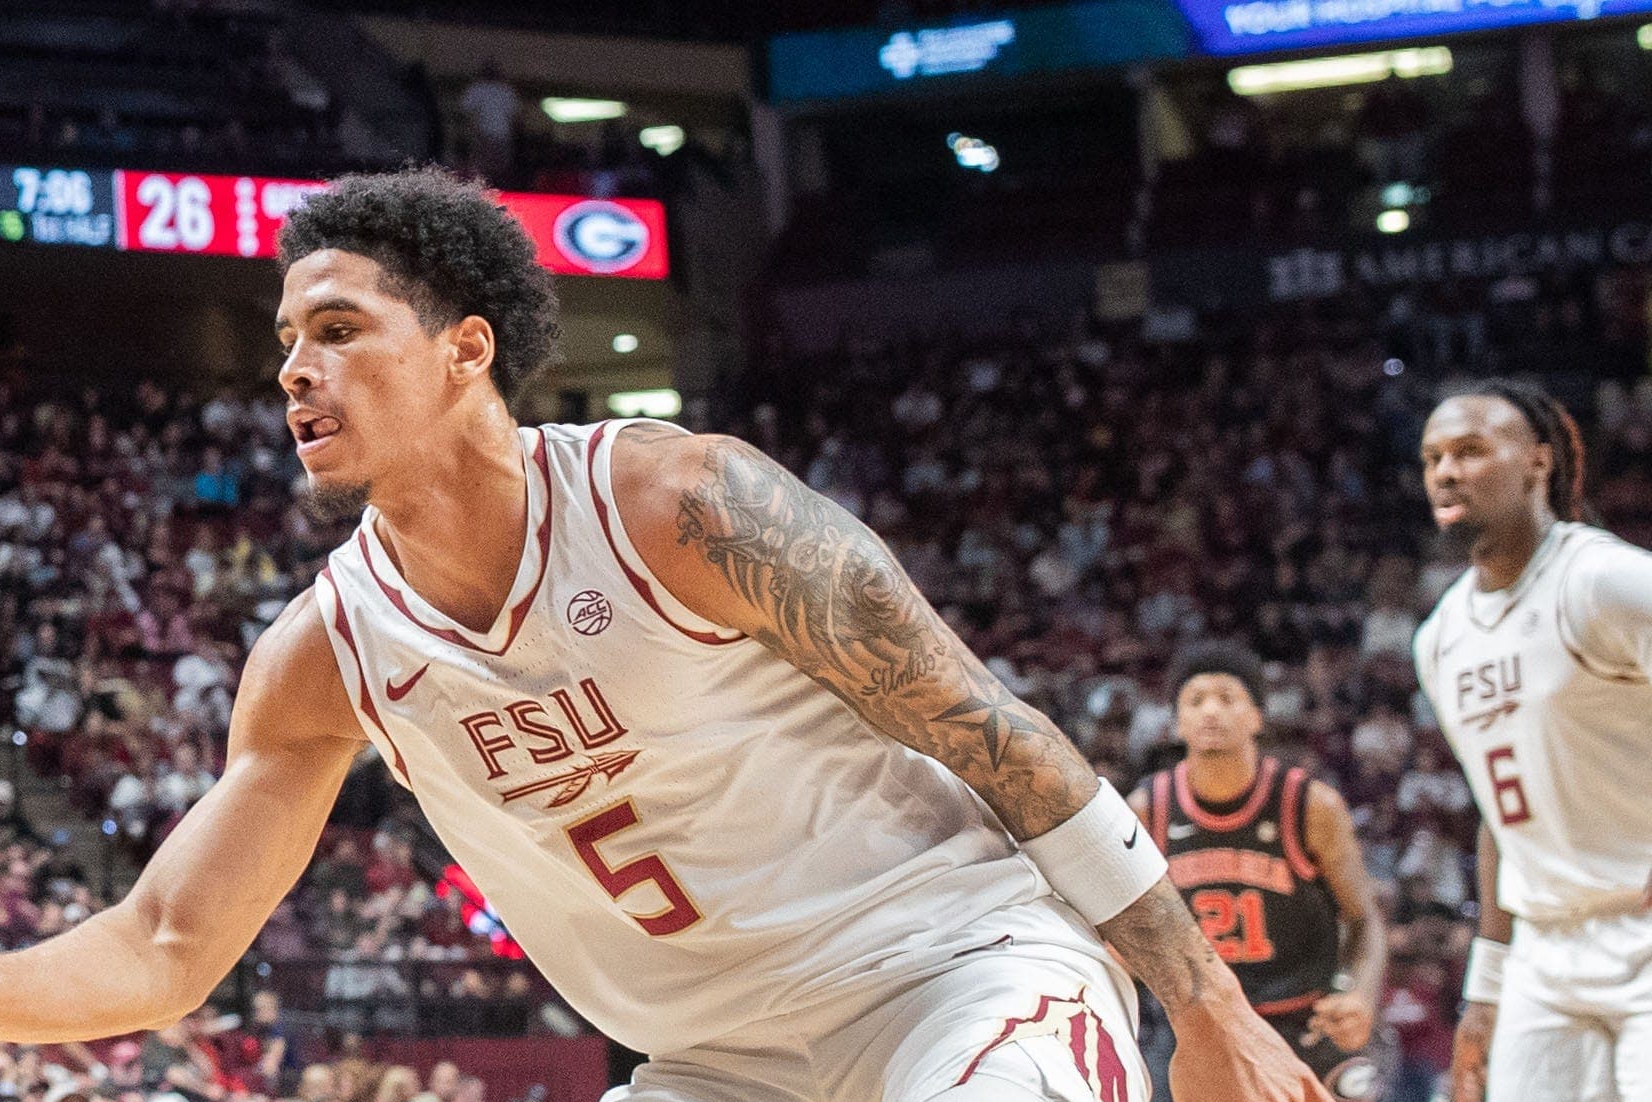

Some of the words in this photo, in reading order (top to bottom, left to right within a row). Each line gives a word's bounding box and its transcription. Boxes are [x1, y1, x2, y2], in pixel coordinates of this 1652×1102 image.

[138, 175, 213, 249] 26
[573, 597, 608, 621] ACC
[1457, 653, 1522, 710] FSU
[458, 677, 629, 782] FSU
[1485, 744, 1532, 827] 6
[561, 794, 707, 941] 5
[1192, 889, 1275, 964] 21
